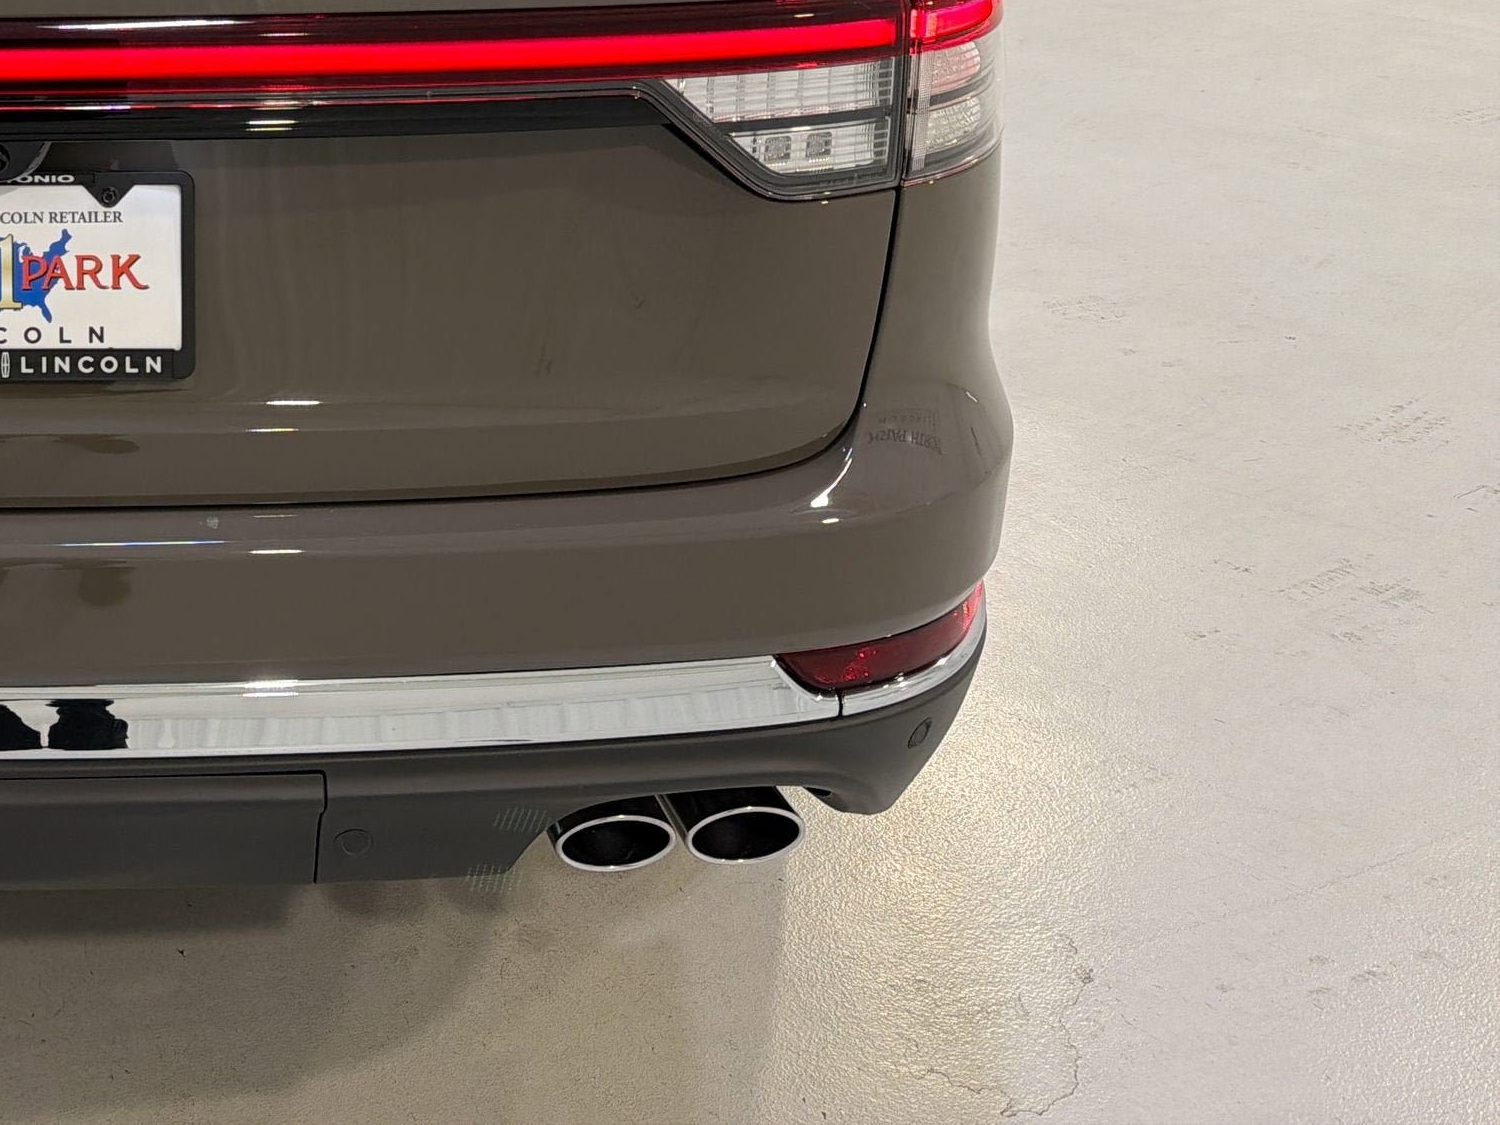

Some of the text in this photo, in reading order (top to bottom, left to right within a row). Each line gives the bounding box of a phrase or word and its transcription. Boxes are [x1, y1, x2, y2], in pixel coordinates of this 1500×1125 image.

[48, 210, 124, 224] RETAILER
[21, 253, 150, 291] PARK
[20, 355, 162, 374] LINCOLN
